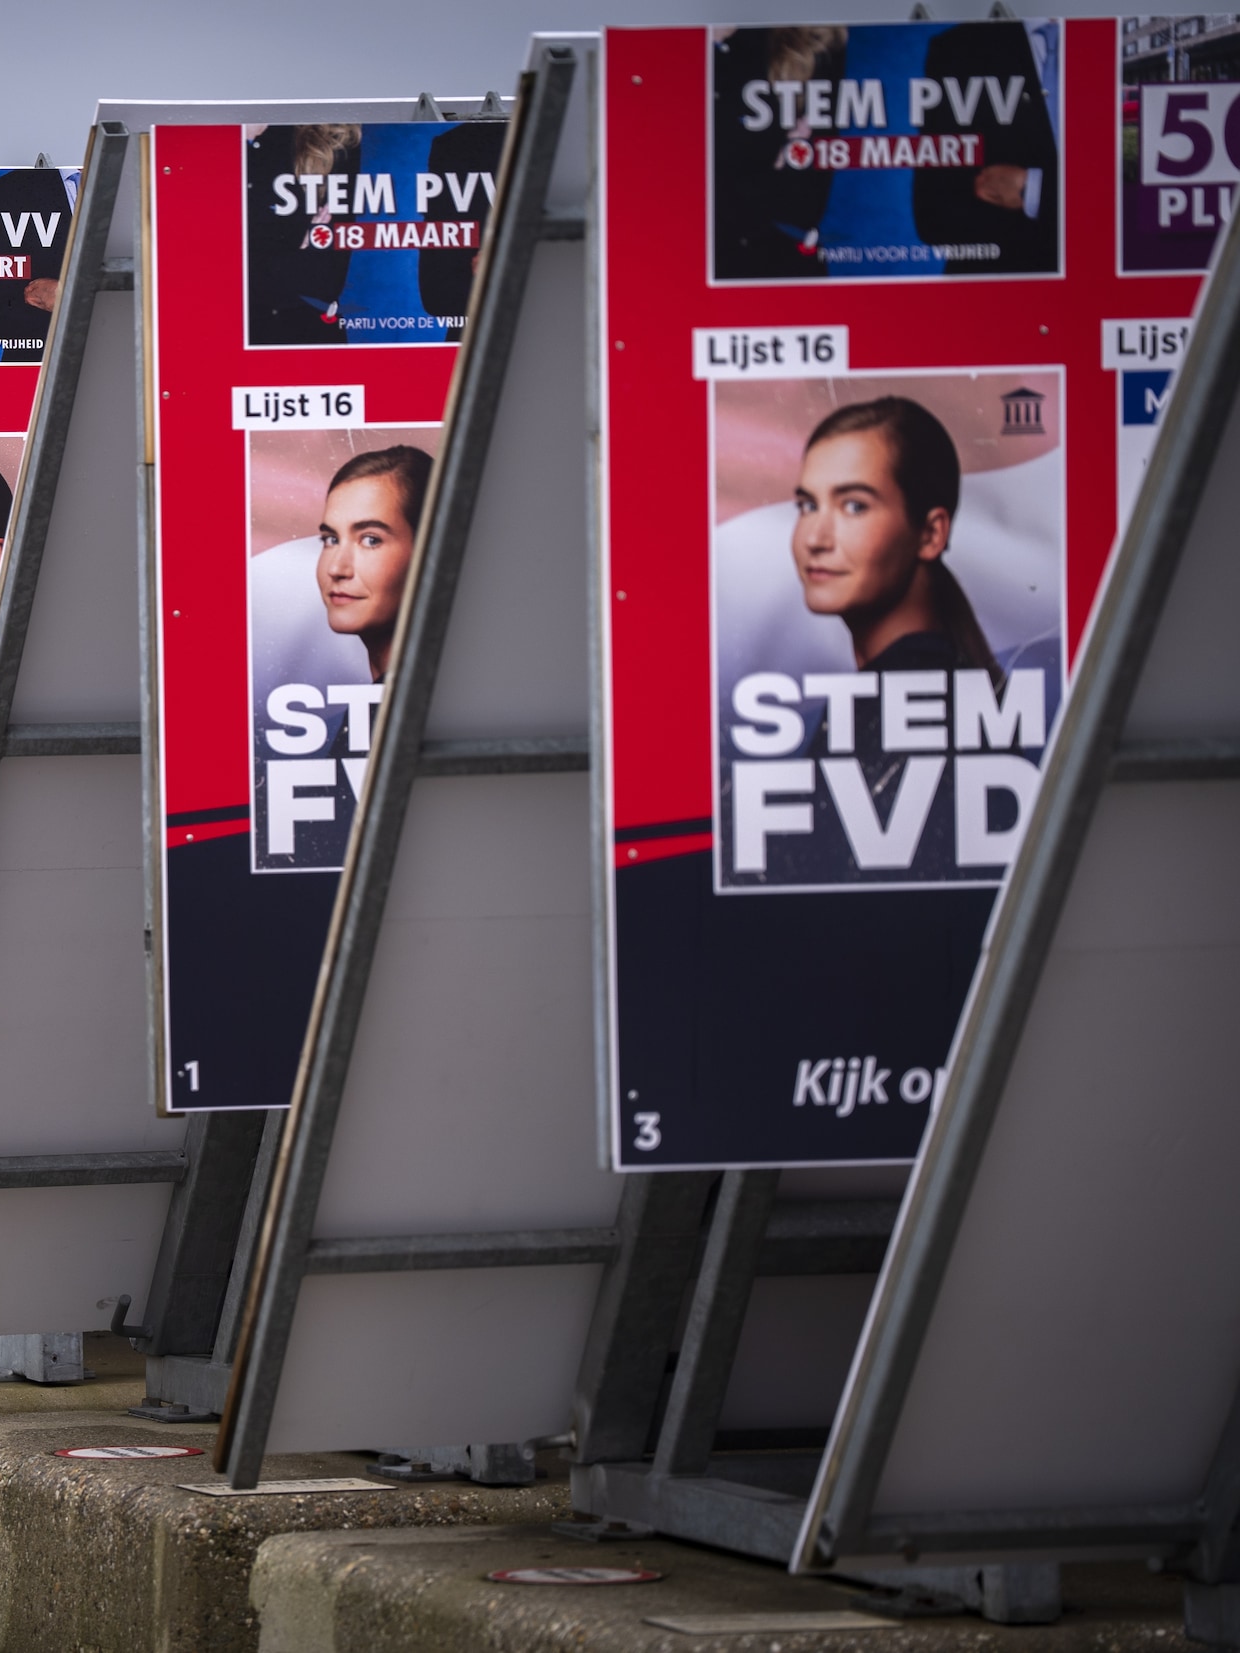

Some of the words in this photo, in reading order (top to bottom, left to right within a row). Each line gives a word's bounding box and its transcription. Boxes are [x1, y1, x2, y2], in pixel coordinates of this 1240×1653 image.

[741, 77, 887, 132] STEM
[909, 75, 1025, 127] PVV
[816, 139, 850, 168] 18
[860, 135, 980, 167] MAART
[1156, 91, 1240, 177] 5
[272, 173, 396, 216] STEM
[334, 225, 365, 249] 18
[374, 222, 475, 248] MAART
[863, 245, 909, 263] VOOR
[911, 244, 930, 262] DE
[931, 243, 1001, 261] VRIJHEID
[338, 317, 376, 330] PARTIJ
[378, 316, 415, 329] VOOR
[418, 316, 434, 328] DE
[707, 335, 785, 370] Lijst
[798, 333, 836, 363] 16
[245, 392, 310, 422] Lijst
[320, 392, 353, 417] 16
[731, 668, 1046, 757] STEM
[267, 757, 368, 856] F
[732, 753, 1042, 873] FVD
[184, 1060, 200, 1092] 1
[792, 1055, 892, 1118] Kijk
[634, 1112, 661, 1151] 3
